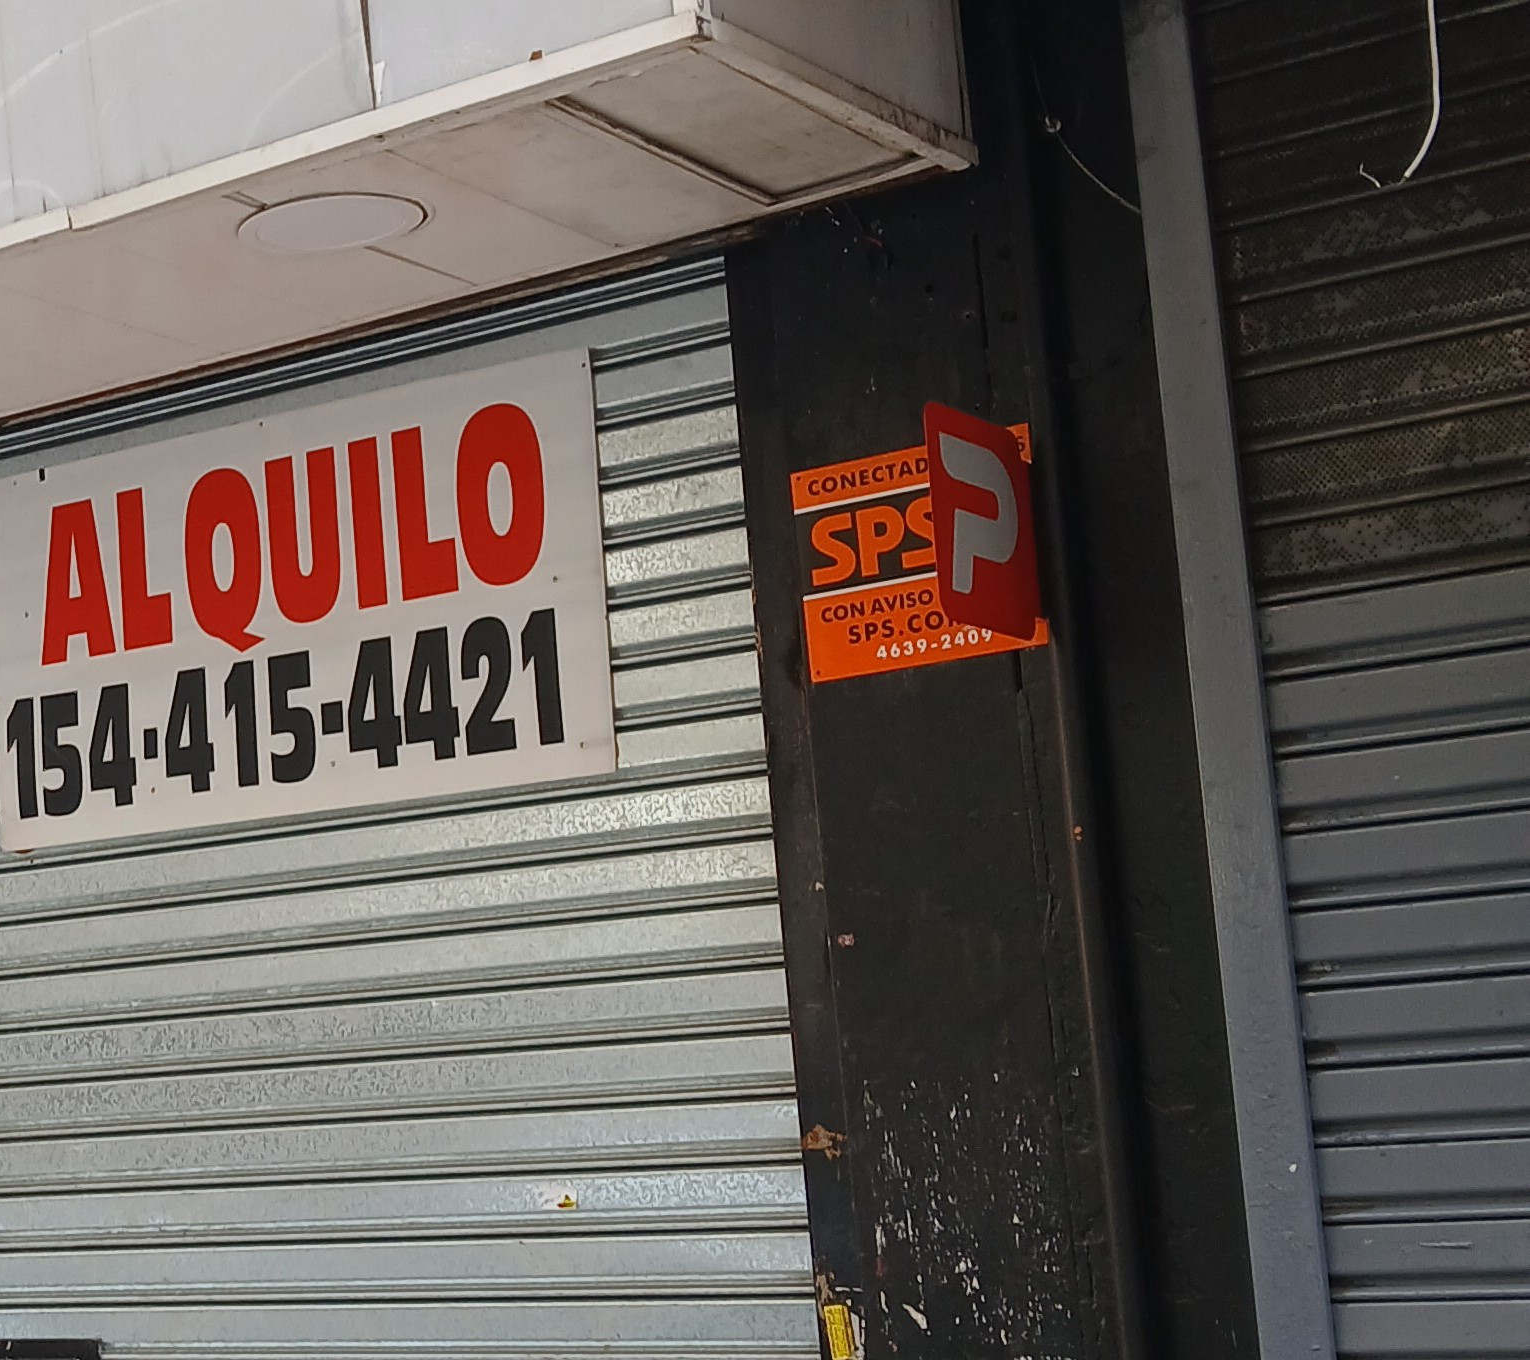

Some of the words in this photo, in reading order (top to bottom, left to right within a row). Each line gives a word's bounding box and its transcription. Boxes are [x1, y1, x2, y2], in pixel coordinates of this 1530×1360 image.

[807, 456, 929, 497] CONECTAD
[41, 403, 545, 666] ALQUILO
[820, 600, 866, 624] CON
[870, 589, 934, 617] AVISO
[876, 627, 993, 660] 4639-2409
